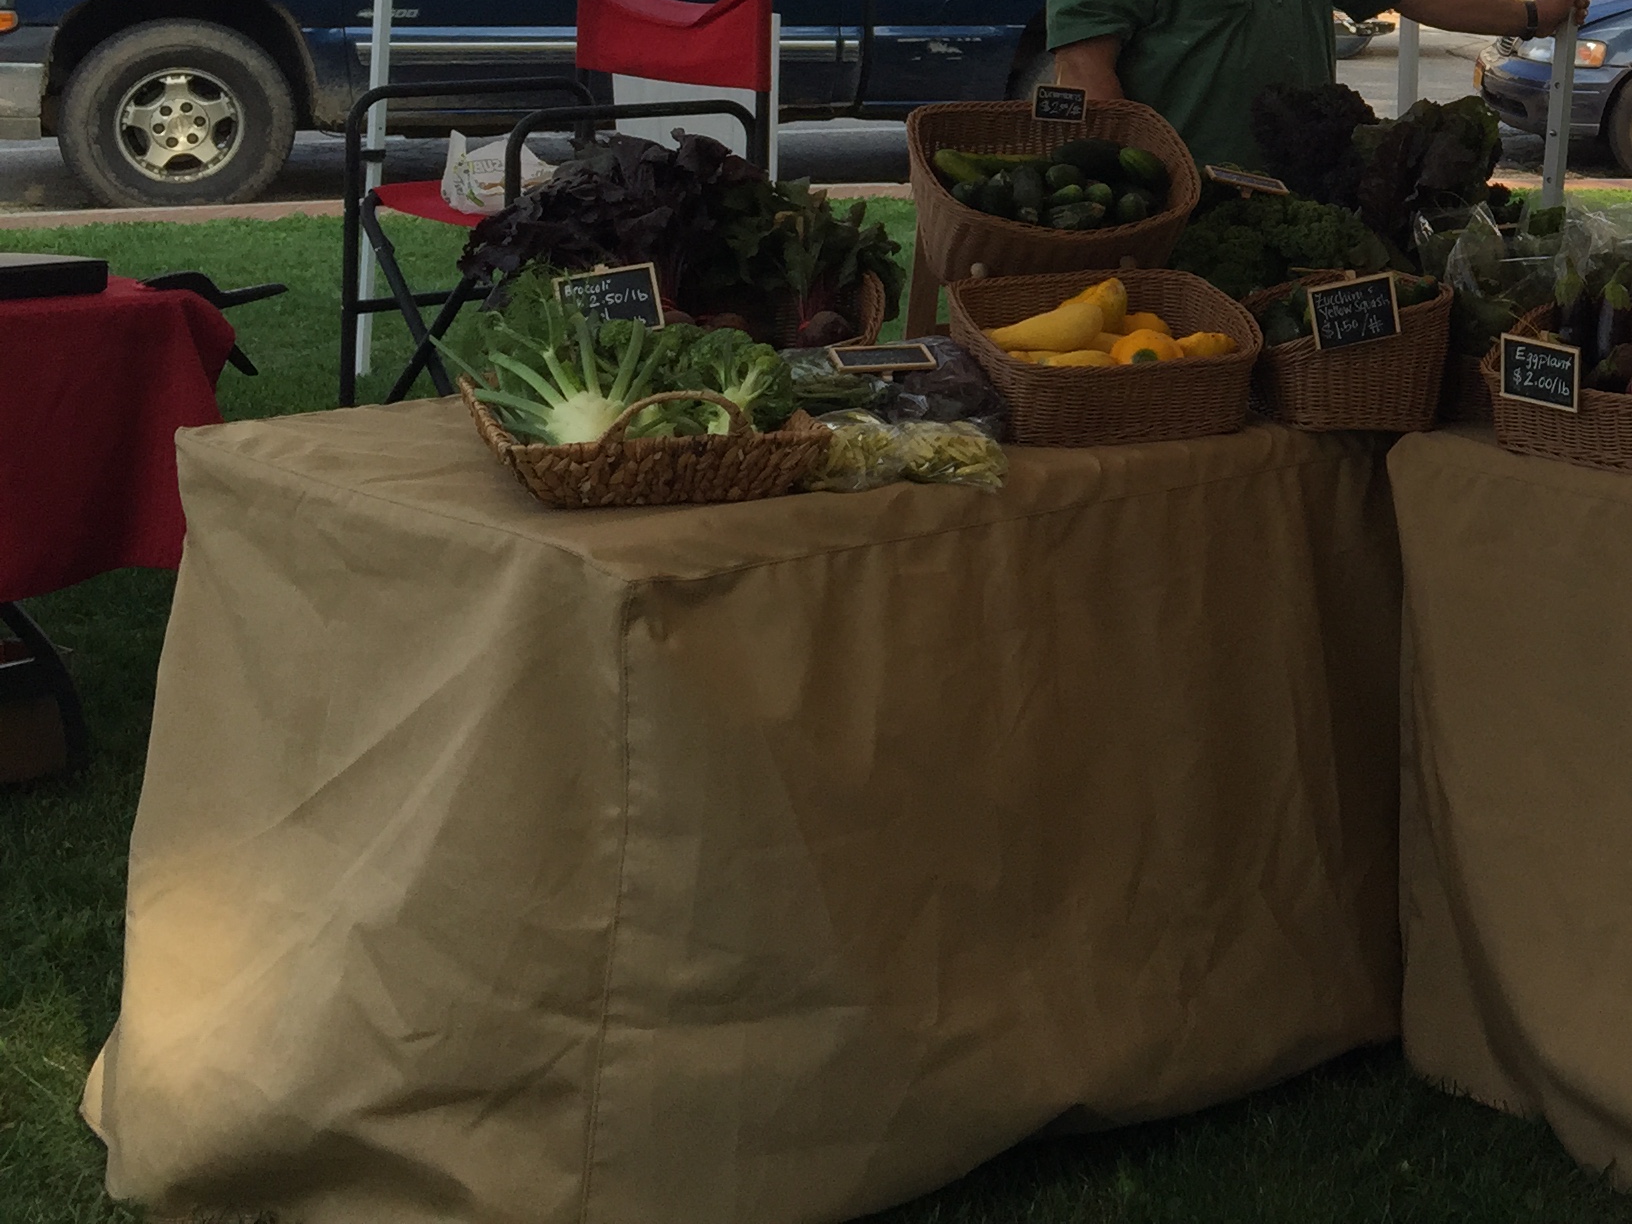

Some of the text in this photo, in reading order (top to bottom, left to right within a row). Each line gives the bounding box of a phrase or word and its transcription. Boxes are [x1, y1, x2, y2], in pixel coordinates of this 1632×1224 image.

[564, 279, 611, 297] Broccoli
[1319, 294, 1391, 320] Yellow Squash
